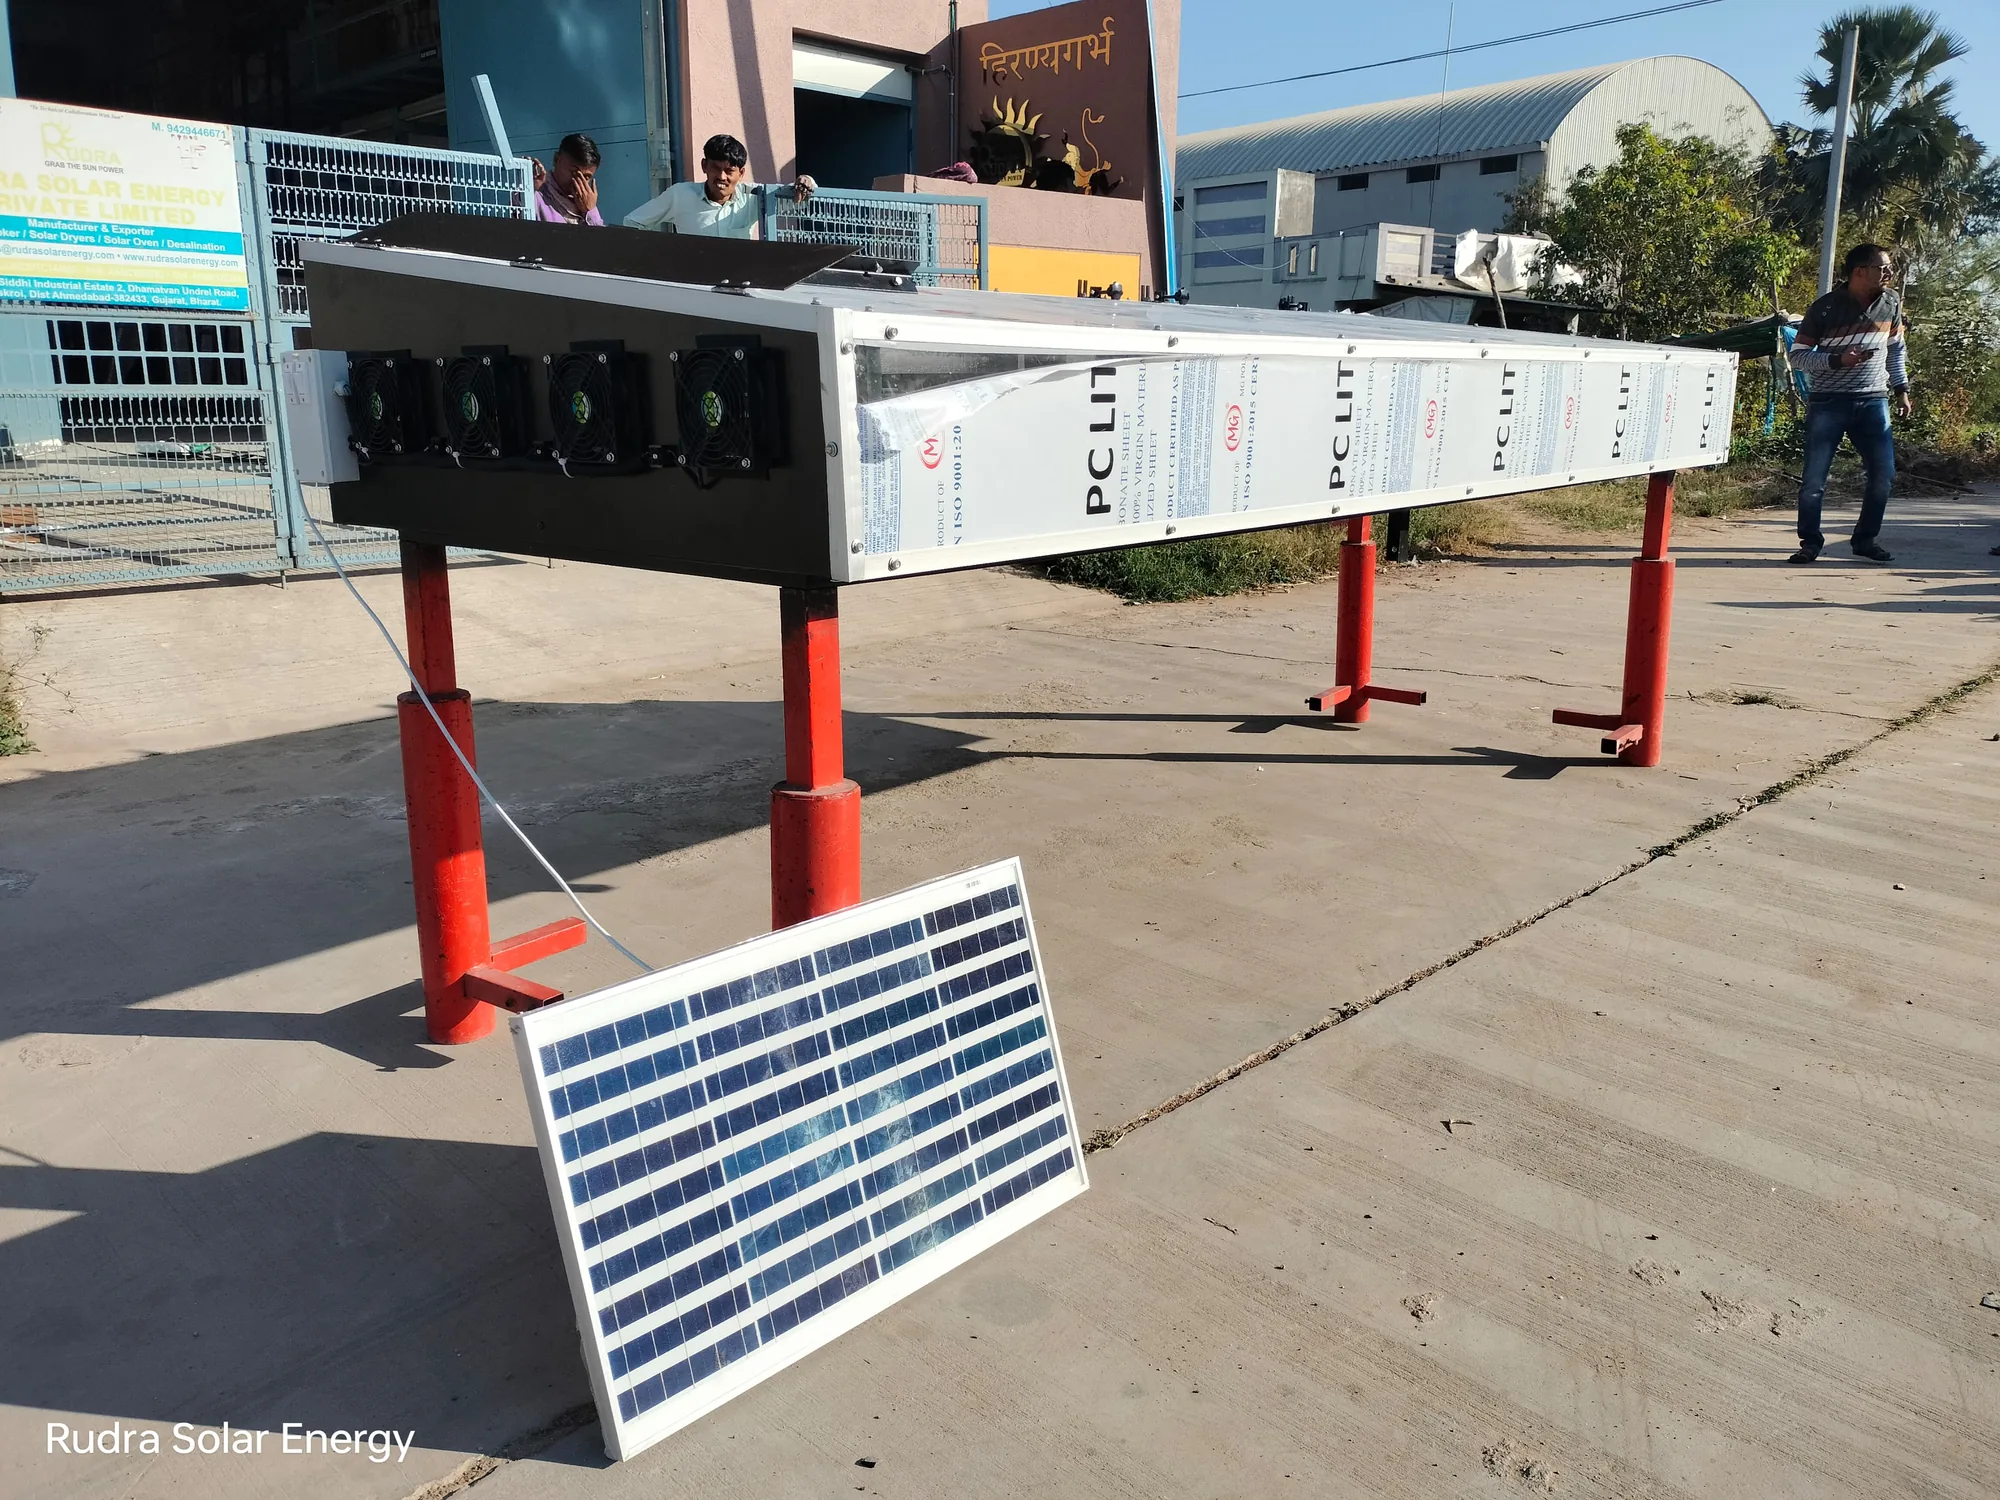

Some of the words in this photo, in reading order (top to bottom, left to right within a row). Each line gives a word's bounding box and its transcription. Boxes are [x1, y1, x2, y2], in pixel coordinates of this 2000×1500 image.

[979, 16, 1115, 84] हिरण्यगर्भ
[151, 122, 164, 132] M.
[166, 124, 226, 138] 9429446671
[44, 160, 66, 169] GRAB
[67, 162, 81, 170] THE
[82, 164, 97, 172] SUN
[98, 166, 124, 174] POWER
[37, 173, 122, 199] SOLAR
[130, 182, 226, 207] ENERGY
[28, 218, 98, 232] Manufacturer
[101, 224, 109, 232] &
[112, 224, 155, 236] Exporter
[99, 202, 196, 225] LIMITED
[30, 230, 58, 240] Solar
[60, 232, 96, 243] Dryers
[104, 236, 130, 245] Solar
[133, 238, 158, 247] Oven
[166, 240, 226, 252] Desalination
[122, 252, 238, 268] www.rudrasolarenergy.com
[30, 290, 50, 299] Dist
[152, 295, 188, 307] Gujarat,
[190, 297, 222, 306] Bharat.
[34, 279, 82, 290] Industrial
[84, 282, 114, 292] Estate
[116, 284, 126, 293] 2,
[128, 284, 180, 295] Dhamatvan
[214, 289, 240, 298] Road,
[1090, 367, 1116, 432] LIT
[1172, 376, 1179, 392] AS
[1335, 360, 1354, 422] LIT
[1500, 362, 1516, 415] LIT
[1618, 364, 1630, 410] LIT
[1704, 367, 1714, 406] LIT
[1121, 411, 1130, 461] SHEET
[1168, 394, 1178, 468] CERTIFIED
[1245, 400, 1256, 468] 9001:2015
[1361, 422, 1370, 466] VIRGIN
[1493, 426, 1510, 472] PC
[1612, 419, 1626, 458] PC
[1700, 414, 1710, 448] PC
[1134, 432, 1144, 486] VIRGIN
[1148, 430, 1158, 478] SHEET
[1329, 434, 1350, 490] PC
[938, 480, 944, 496] OF
[1086, 447, 1114, 515] PC
[954, 497, 962, 528] ISO
